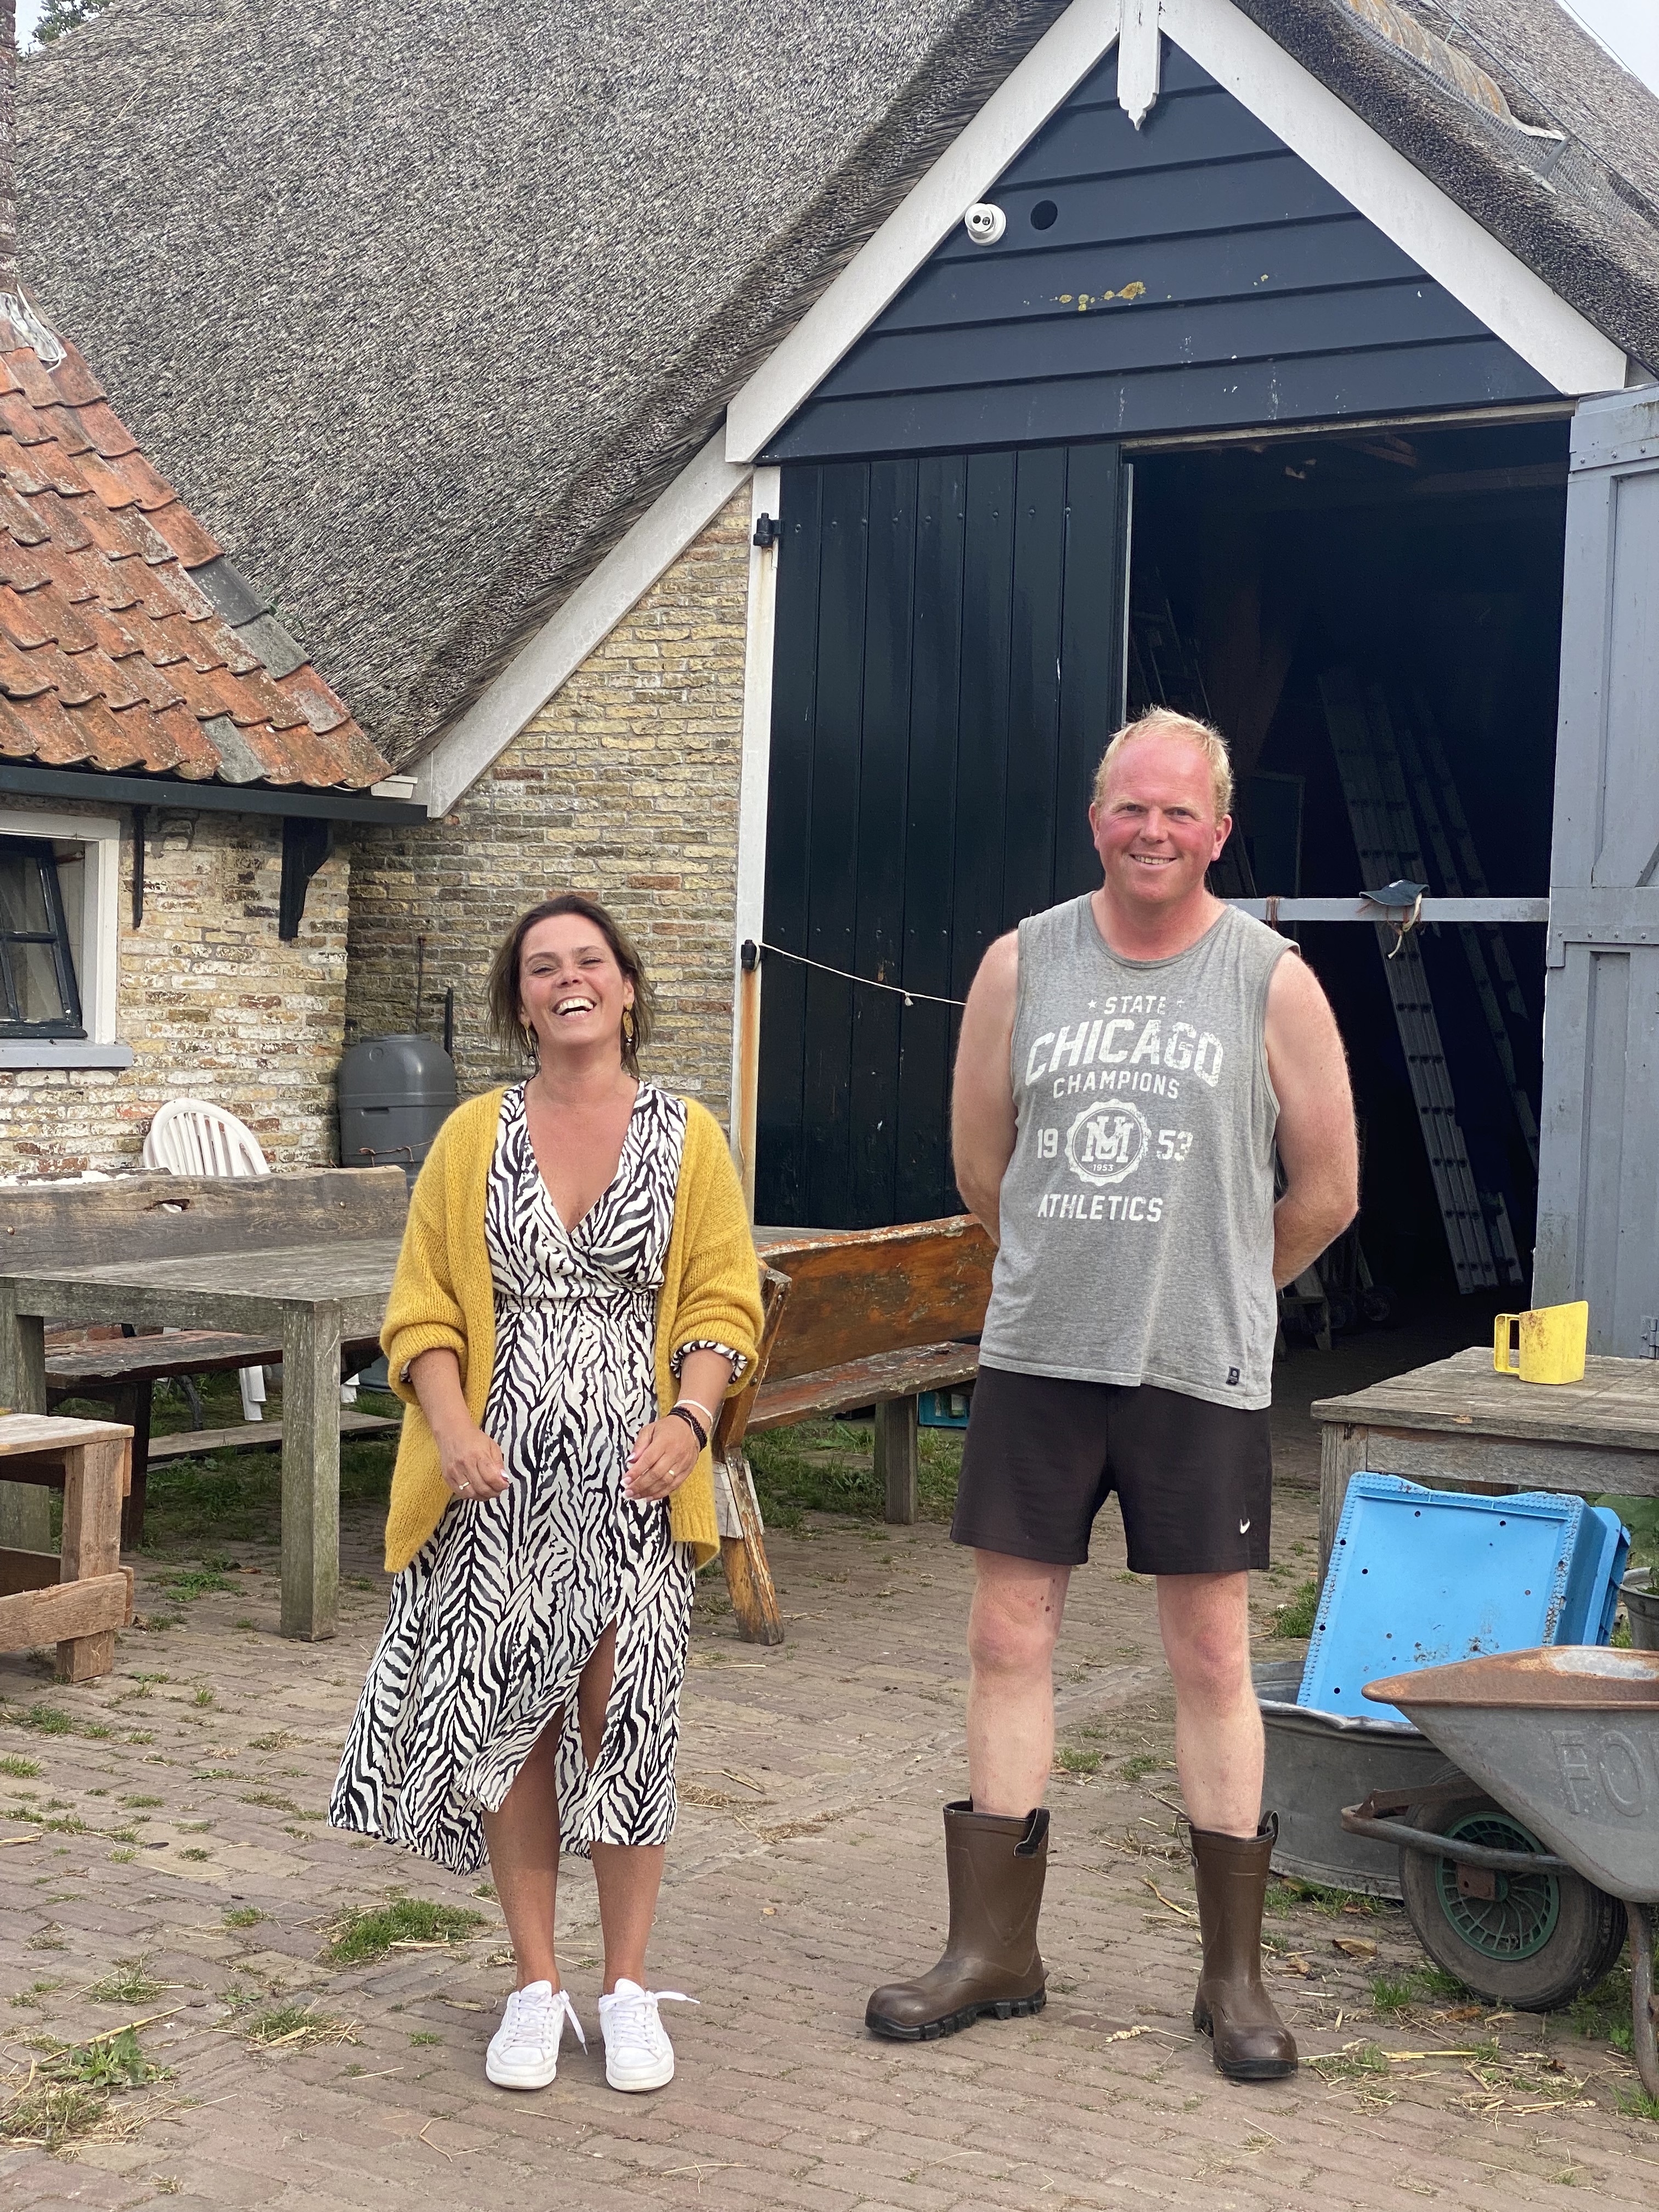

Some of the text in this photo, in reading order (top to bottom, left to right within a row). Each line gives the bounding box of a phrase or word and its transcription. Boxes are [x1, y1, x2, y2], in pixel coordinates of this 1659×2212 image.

[1104, 996, 1166, 1015] STATE
[1025, 1019, 1224, 1087] CHICAGO
[1053, 1071, 1180, 1099] CHAMPIONS
[1037, 1128, 1194, 1161] 19 53
[1093, 1164, 1114, 1172] 1953
[1037, 1193, 1164, 1222] ATHLETICS
